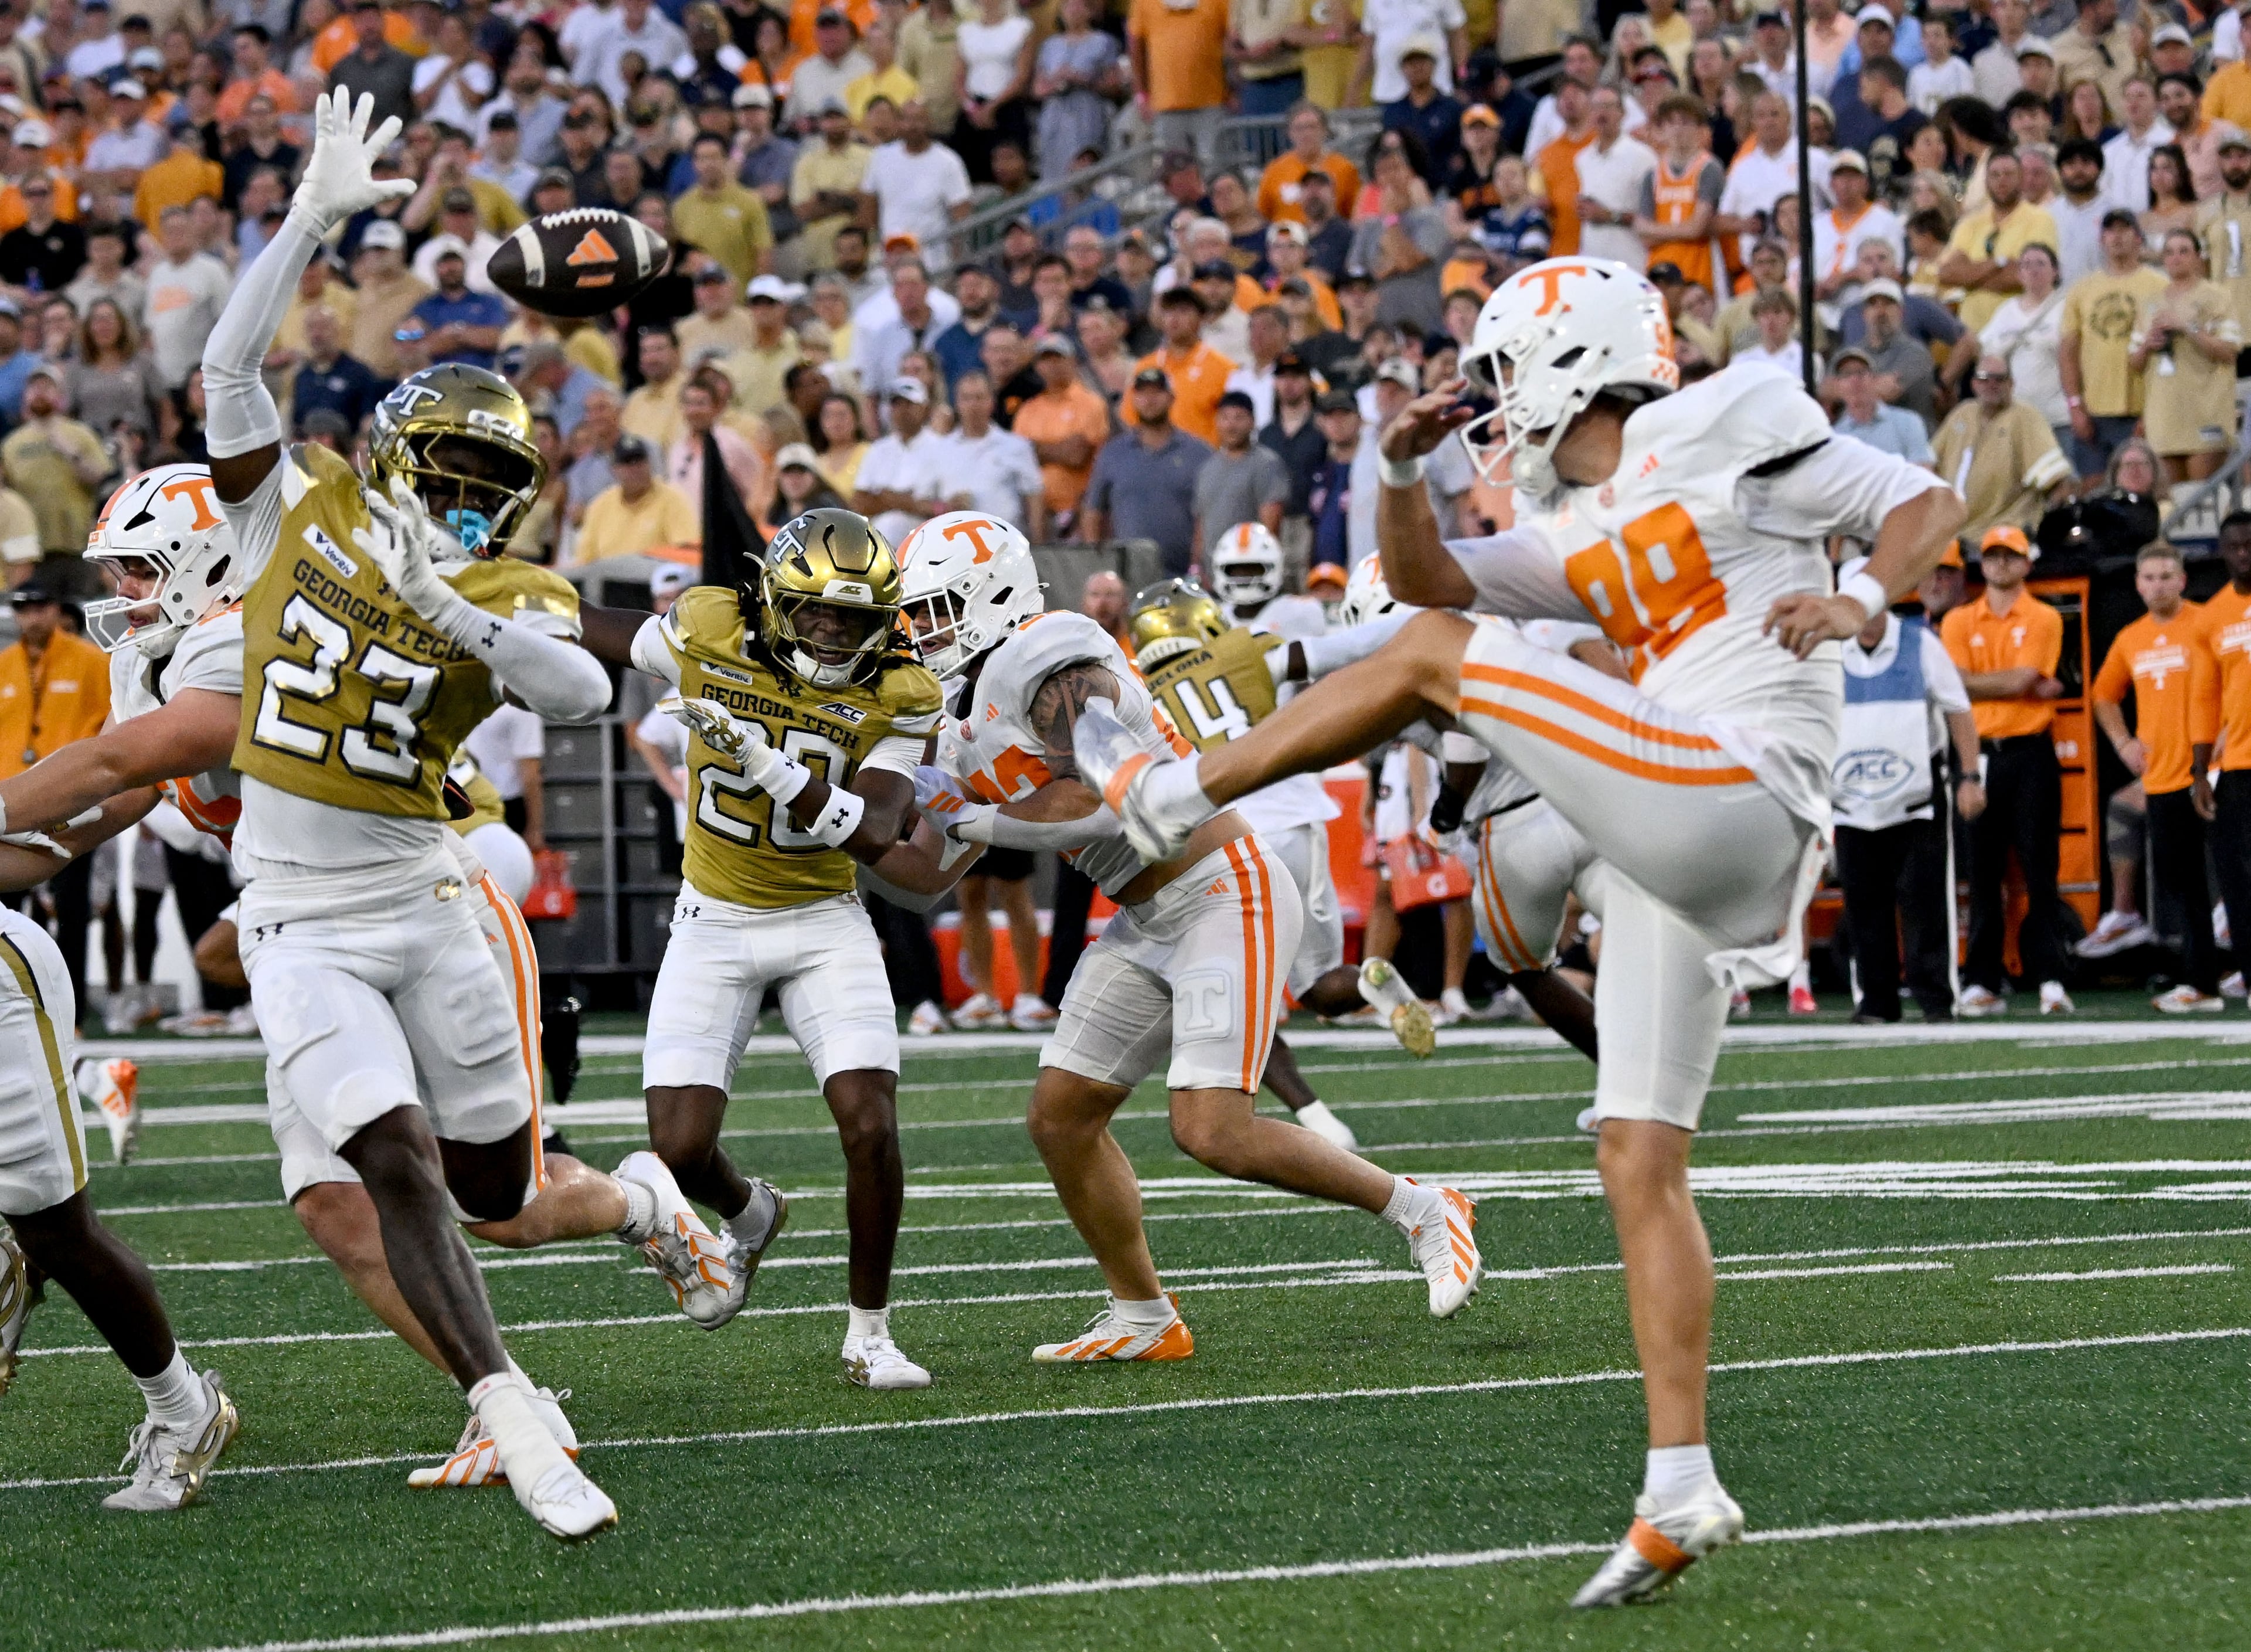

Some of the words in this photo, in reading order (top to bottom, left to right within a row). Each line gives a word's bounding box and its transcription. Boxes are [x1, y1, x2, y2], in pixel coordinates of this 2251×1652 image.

[1518, 265, 1587, 317] T
[161, 478, 222, 532] T
[941, 519, 994, 565] T
[293, 558, 391, 636] GEORGIA
[397, 621, 465, 661] TECH
[837, 584, 863, 594] ACC
[250, 589, 445, 790] 23
[720, 668, 749, 684] Veritiv
[701, 682, 795, 720] GEORGIA
[802, 712, 860, 750] TECH
[824, 702, 866, 721] ACC
[695, 714, 856, 854] 20
[1844, 757, 1898, 780] ACC
[1175, 975, 1225, 1032] T
